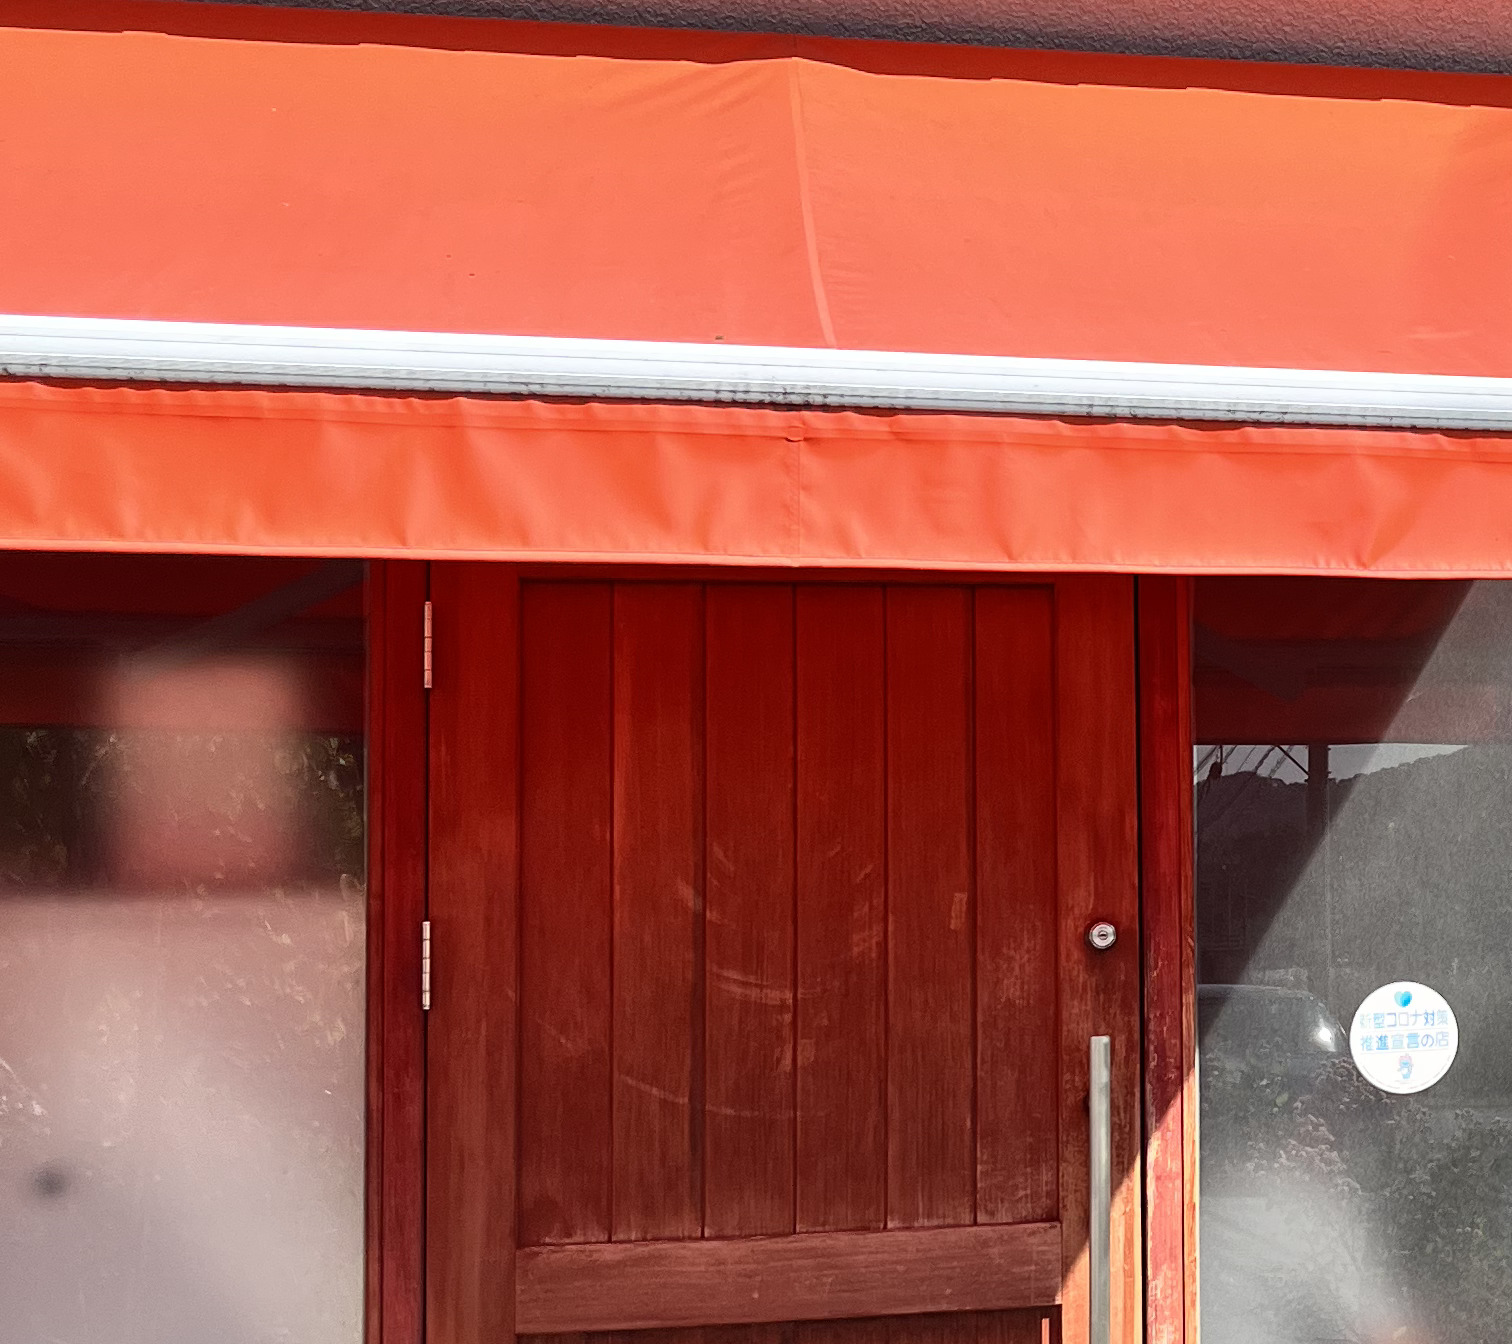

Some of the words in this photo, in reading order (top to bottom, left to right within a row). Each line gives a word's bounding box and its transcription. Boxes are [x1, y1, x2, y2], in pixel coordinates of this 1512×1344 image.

[1360, 1009, 1449, 1029] 新型コロナ対策
[1360, 1032, 1449, 1052] 推進宣言の店
